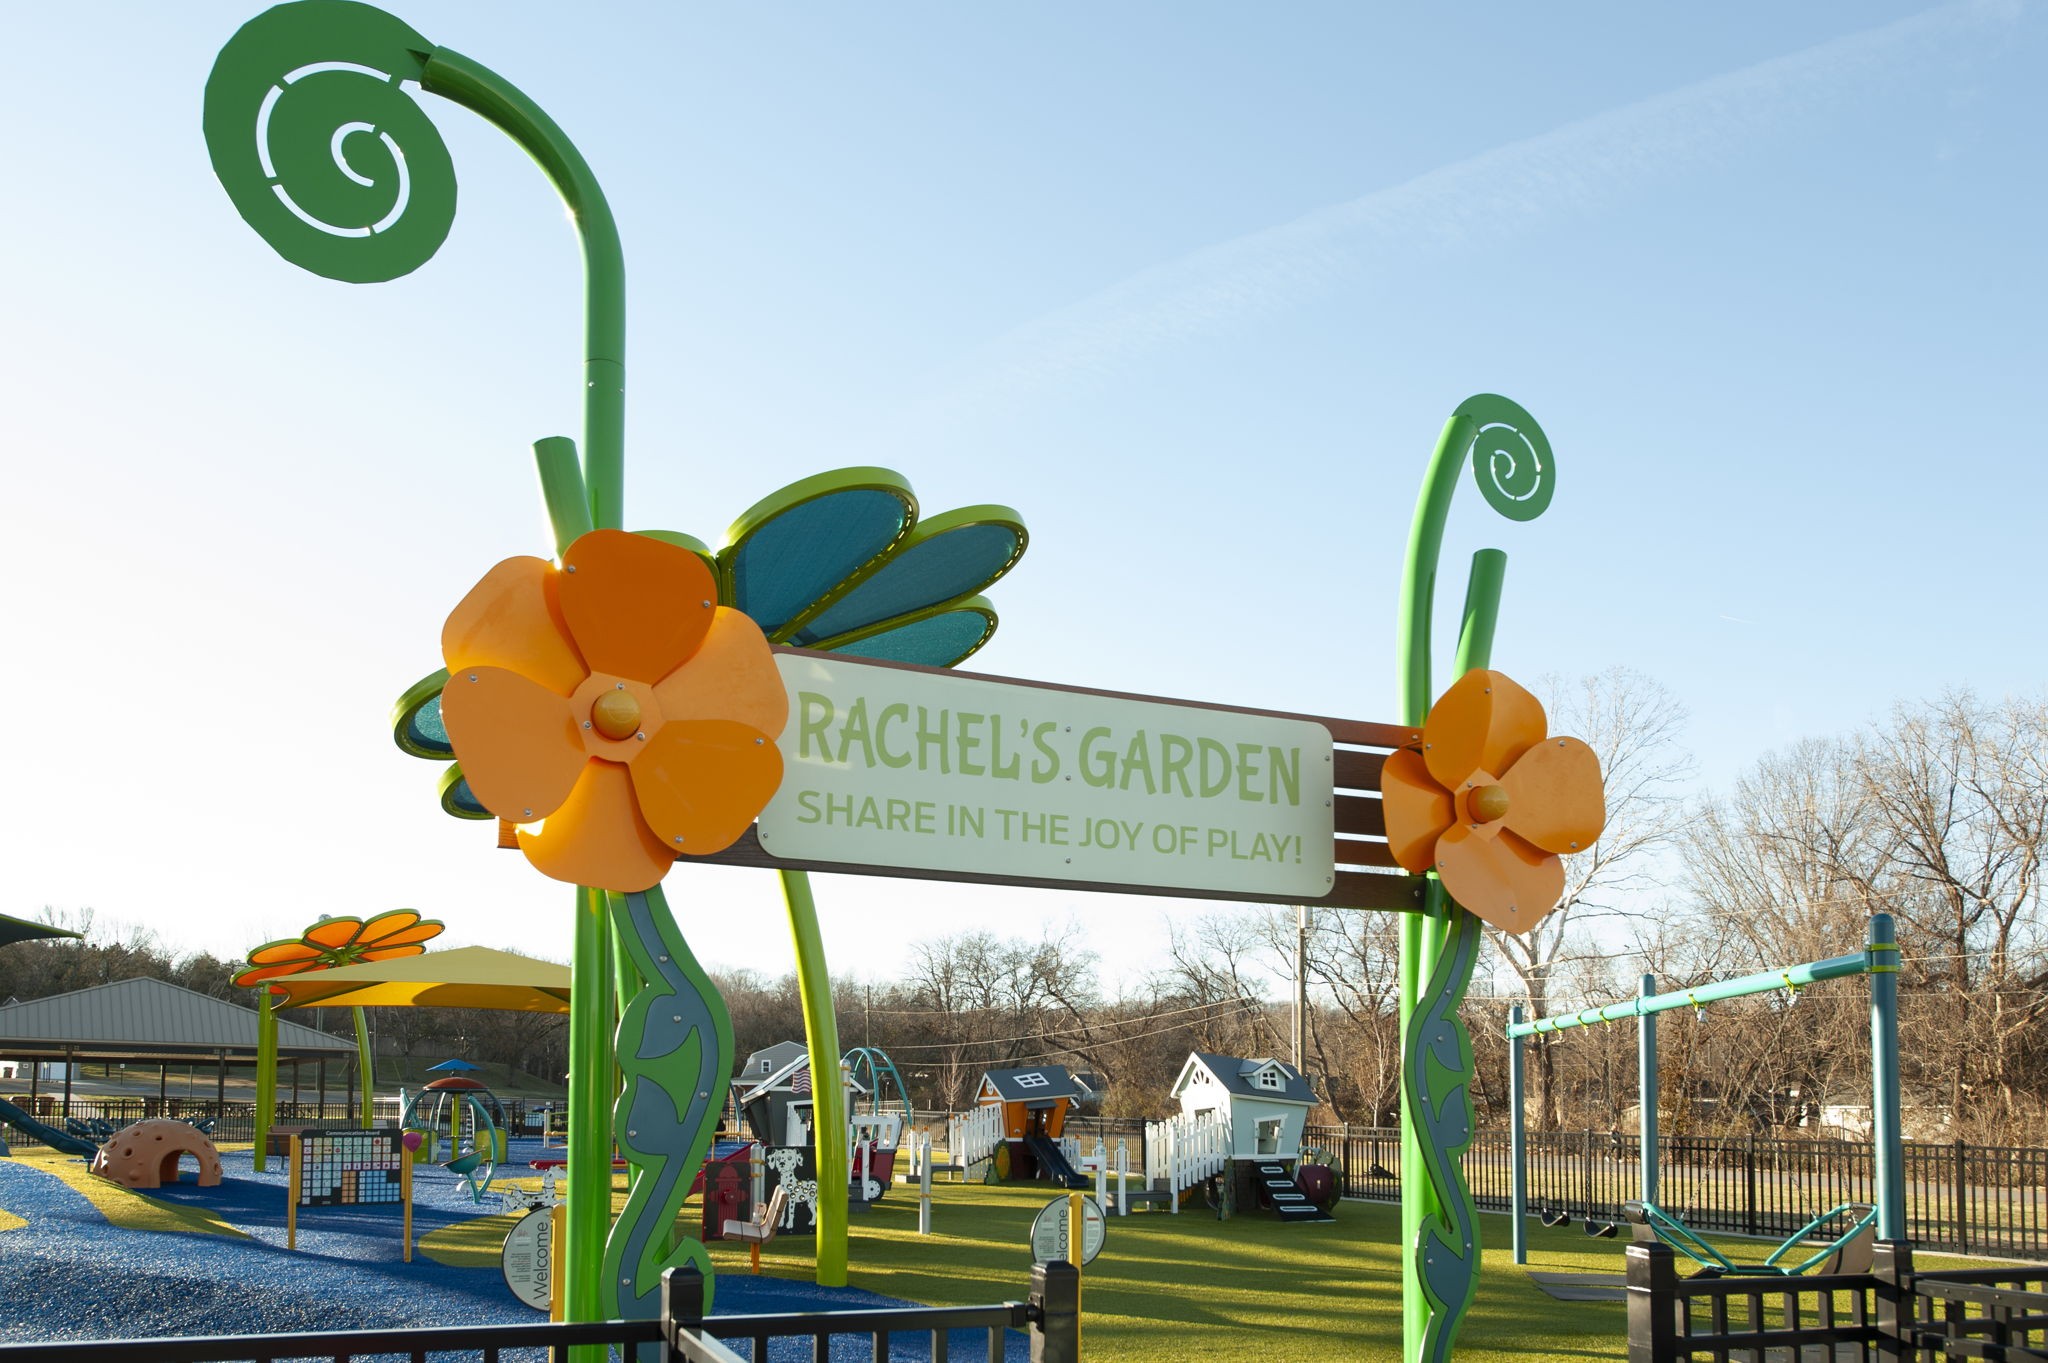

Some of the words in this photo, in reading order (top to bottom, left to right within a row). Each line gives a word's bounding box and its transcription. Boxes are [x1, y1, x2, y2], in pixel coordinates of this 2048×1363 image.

[798, 691, 1061, 784] RACHEL'S
[1078, 726, 1301, 807] GARDEN
[796, 790, 936, 835] SHARE
[948, 804, 985, 839] IN
[995, 808, 1070, 847] THE
[1078, 817, 1145, 851] JOY
[1152, 823, 1199, 855] OF
[1207, 828, 1302, 865] PLAY!
[533, 1221, 549, 1300] Welcome
[1056, 1209, 1068, 1261] elcome
